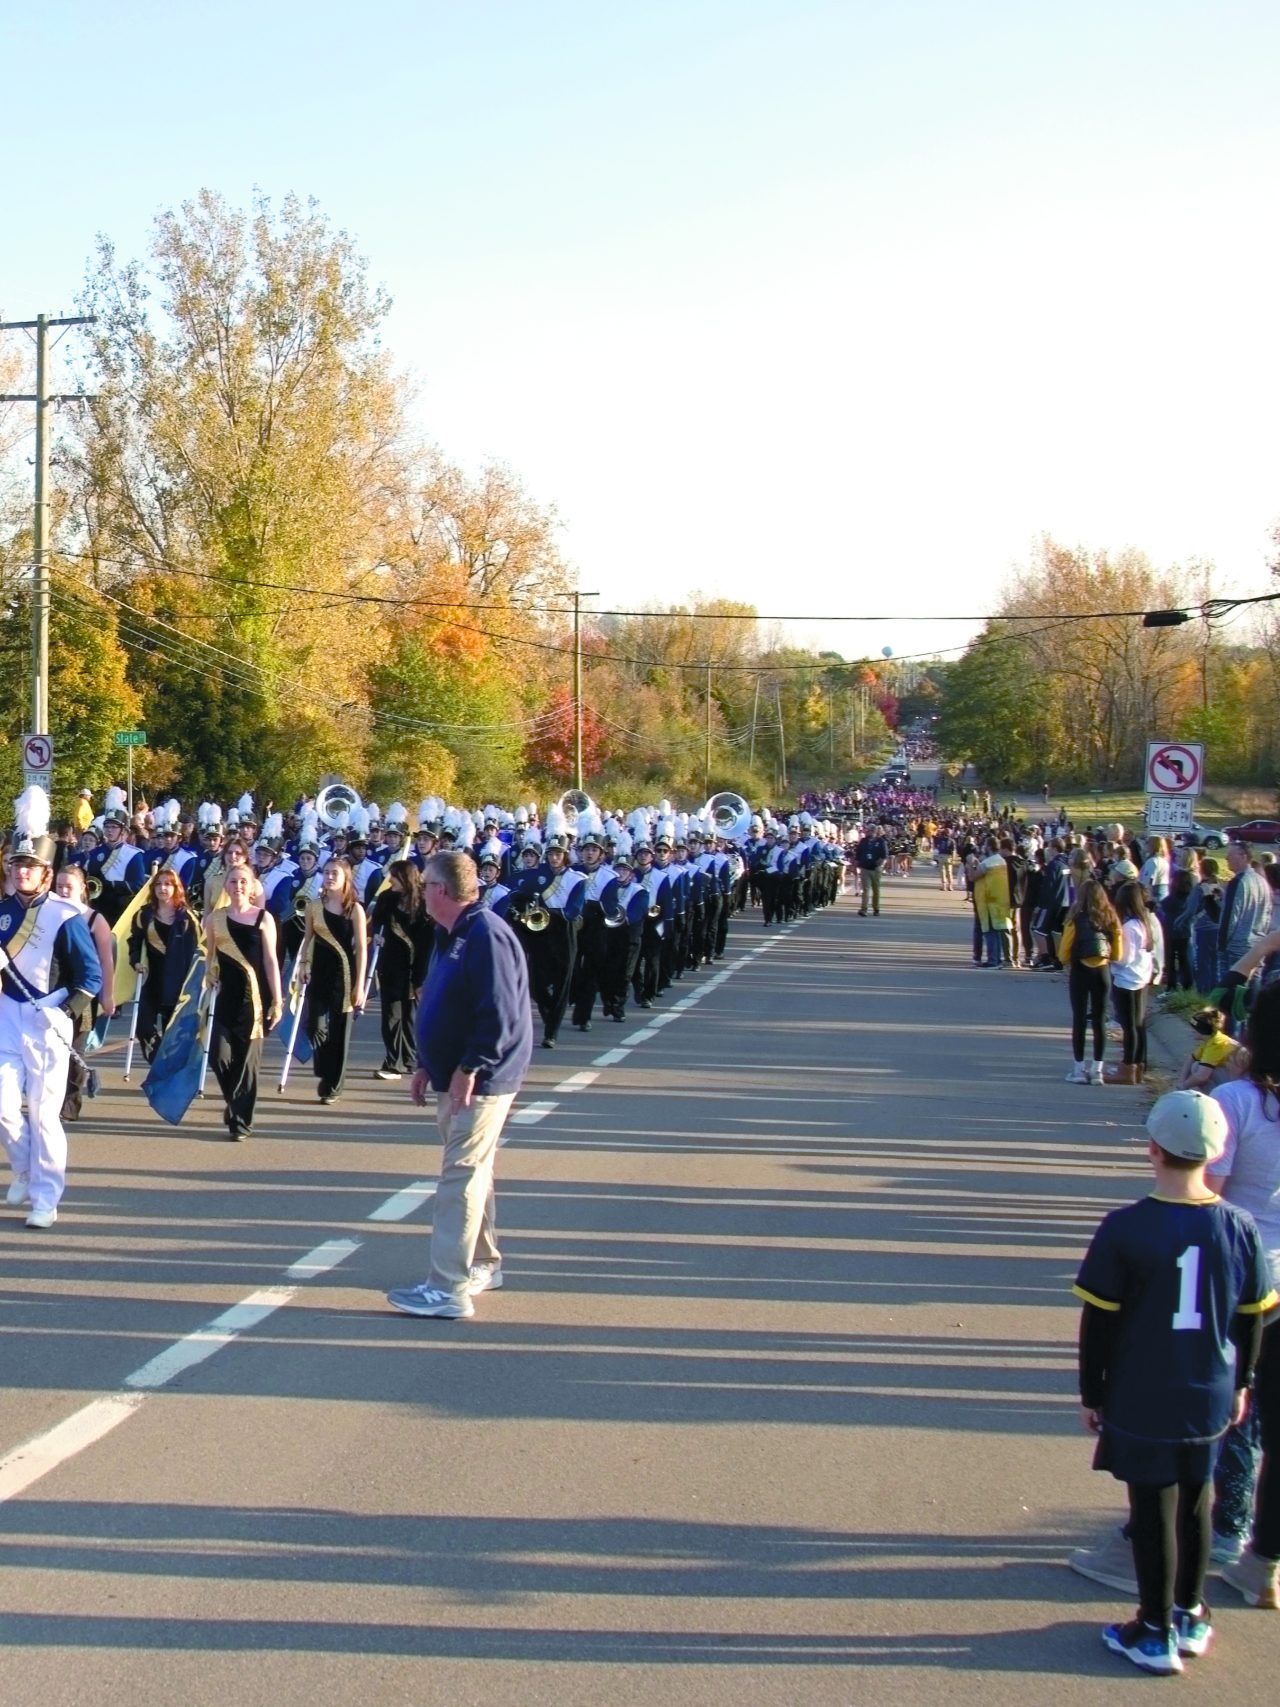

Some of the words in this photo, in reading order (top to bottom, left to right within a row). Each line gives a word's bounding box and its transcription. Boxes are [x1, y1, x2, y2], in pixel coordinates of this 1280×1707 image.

[116, 733, 139, 744] State
[1154, 800, 1171, 809] 2:15
[1175, 801, 1187, 809] PM
[1152, 810, 1160, 822] TO
[1181, 811, 1190, 823] PM
[1172, 1245, 1202, 1330] 1
